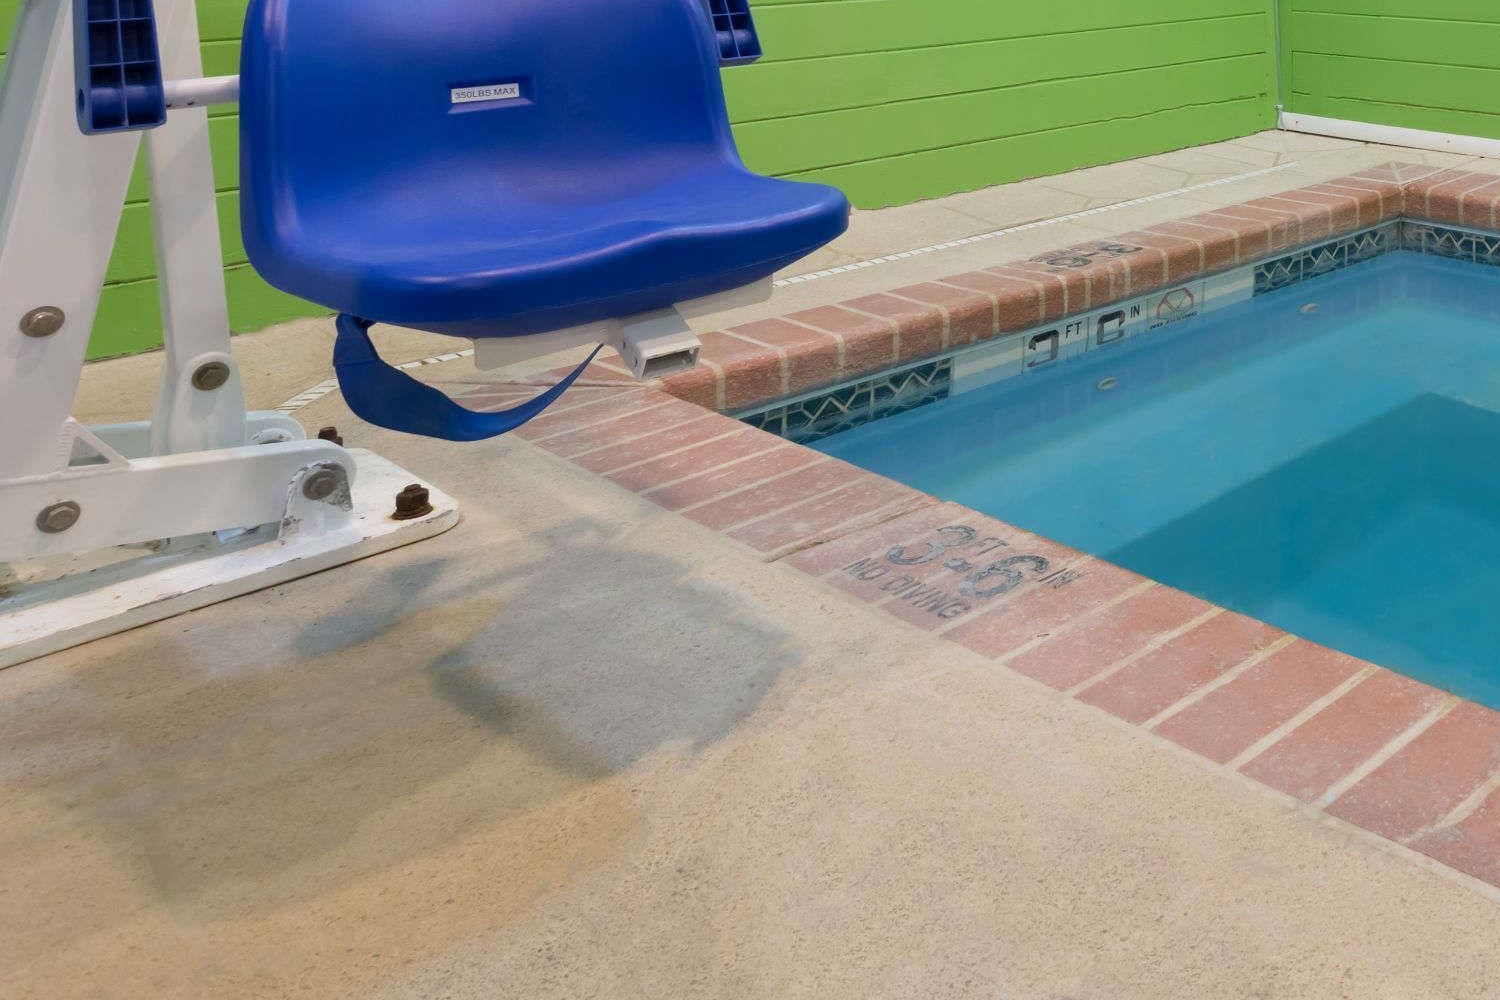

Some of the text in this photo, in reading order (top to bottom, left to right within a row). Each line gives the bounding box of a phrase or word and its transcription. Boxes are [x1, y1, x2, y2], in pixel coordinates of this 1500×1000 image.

[1065, 321, 1082, 338] FT
[1130, 304, 1141, 319] IN
[842, 557, 972, 619] NO DIVING
